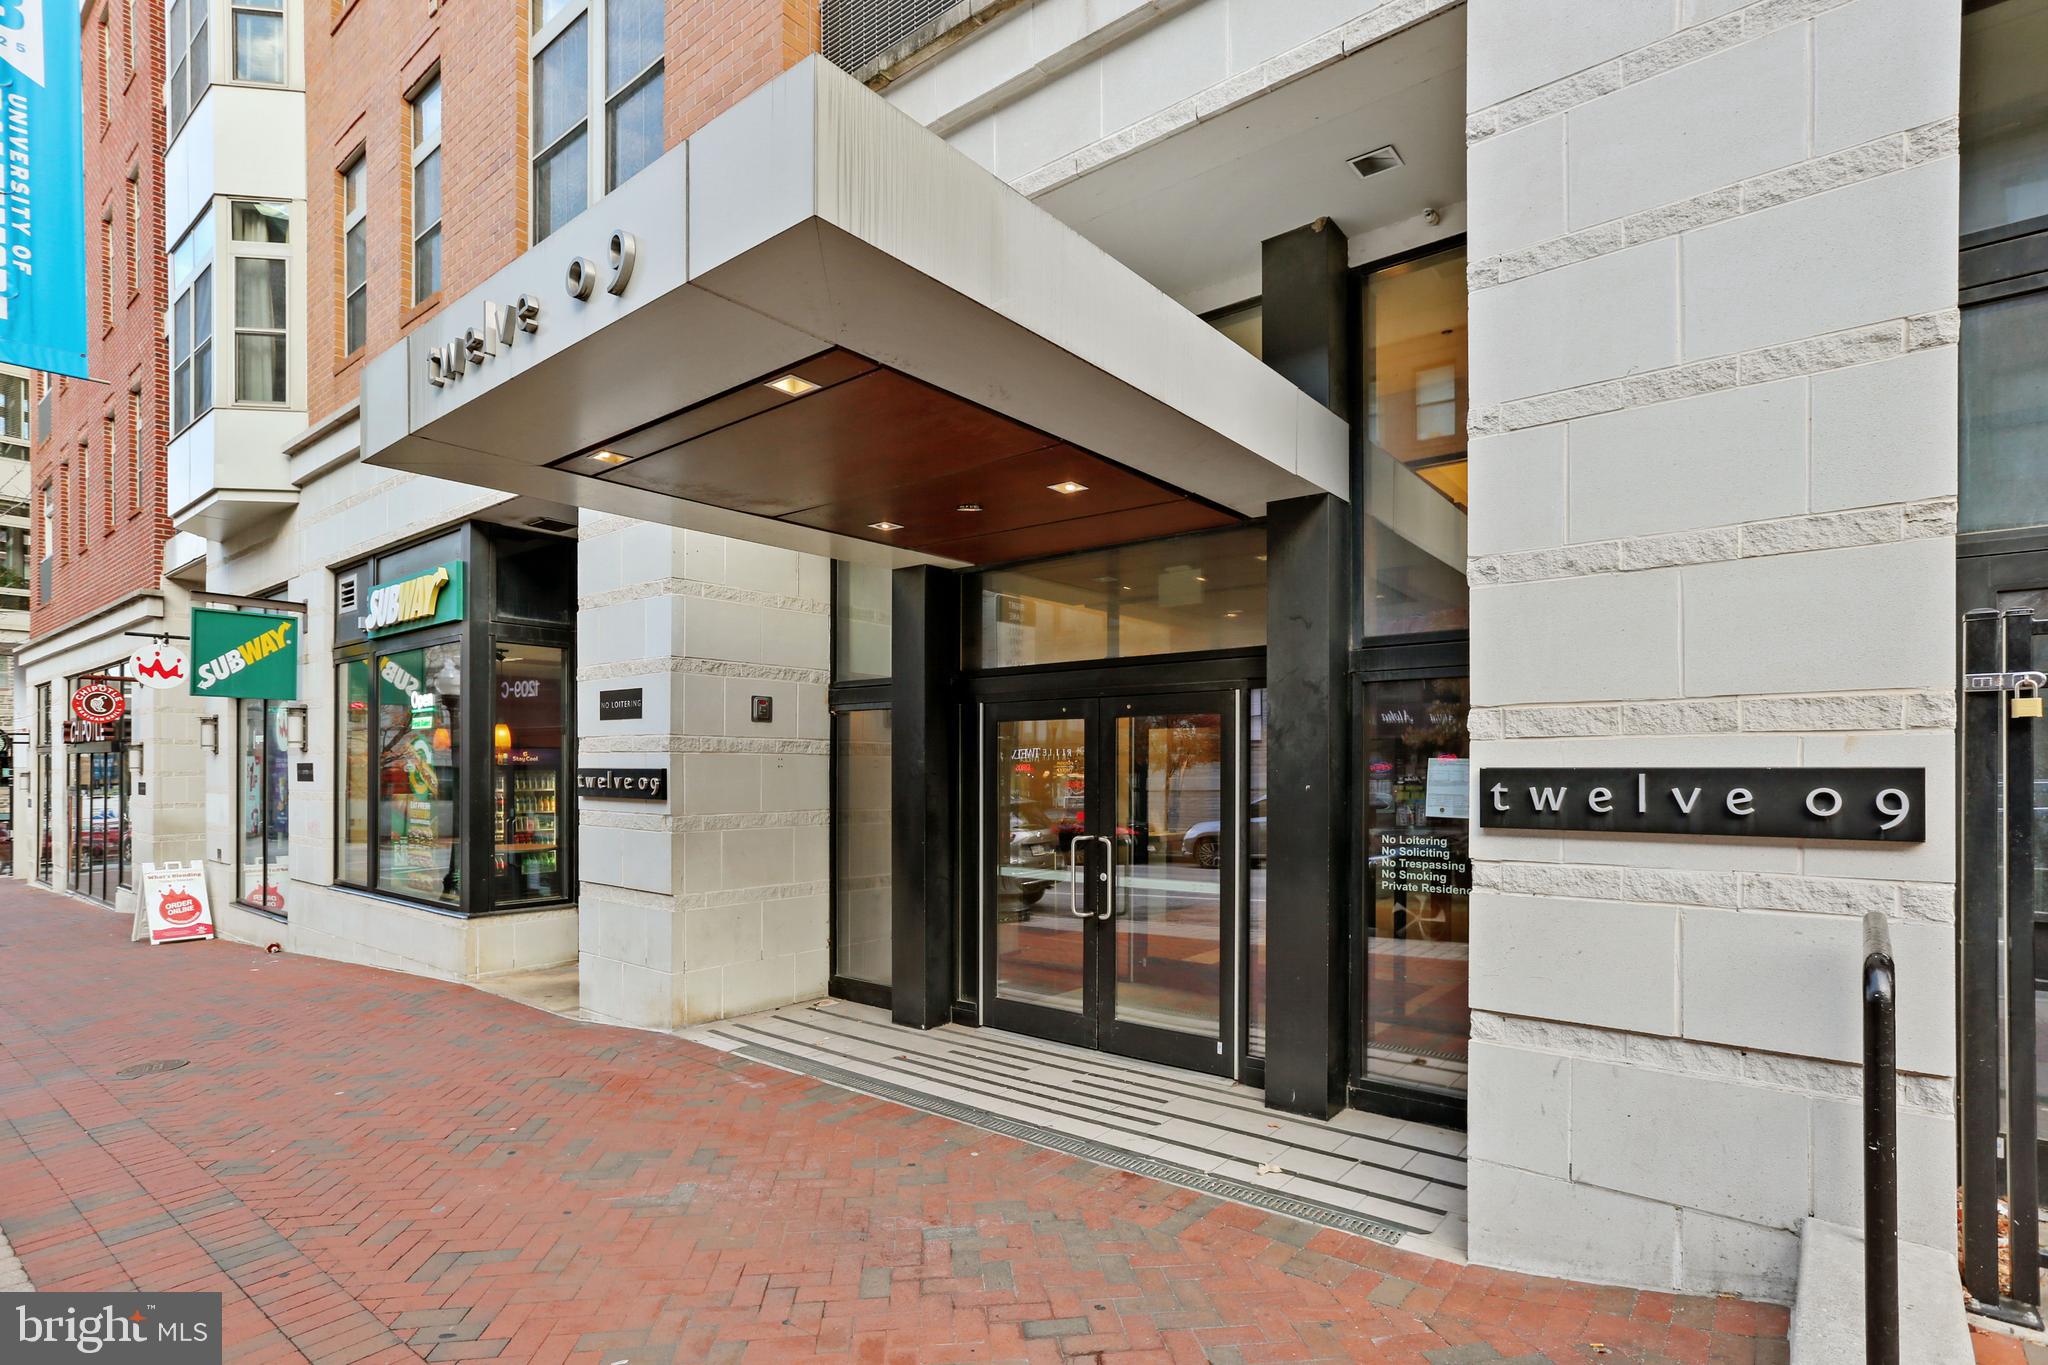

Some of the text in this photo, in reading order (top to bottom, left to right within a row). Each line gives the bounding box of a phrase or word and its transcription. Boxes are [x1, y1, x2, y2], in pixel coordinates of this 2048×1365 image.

[7, 93, 32, 276] UNIVERSITY OF
[365, 567, 449, 631] SUBWAY
[196, 621, 292, 690] SUBWAY
[75, 684, 124, 702] CHIPOTLE
[411, 691, 434, 709] Open
[611, 699, 641, 709] LOITERING
[577, 771, 633, 789] twelve
[1490, 773, 1755, 816] twelve
[1381, 835, 1447, 848] No Loitering
[1381, 846, 1450, 860] No Soliciting
[1381, 858, 1465, 873] No Trespassing
[1381, 869, 1447, 884] No Smoking
[1381, 881, 1418, 891] Private
[165, 899, 193, 910] ORDER
[167, 905, 195, 916] ONLINE
